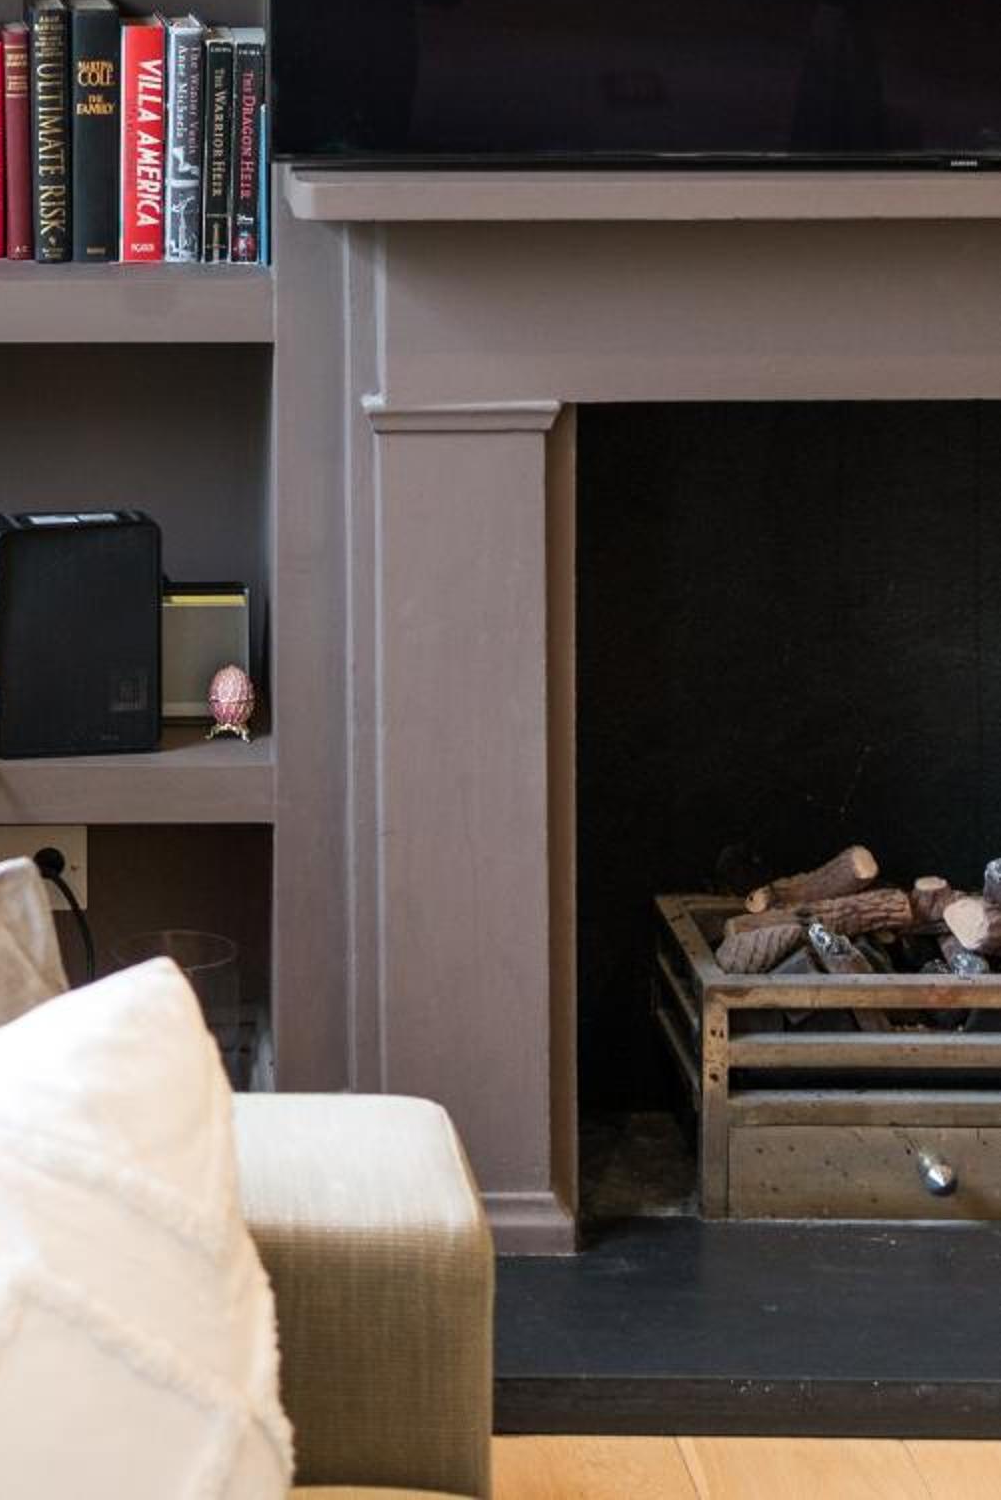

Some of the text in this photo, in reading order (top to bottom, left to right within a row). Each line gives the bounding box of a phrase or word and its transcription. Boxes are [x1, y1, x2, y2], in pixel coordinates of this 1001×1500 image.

[77, 69, 115, 87] COLE
[36, 62, 64, 177] ULTIMATE
[76, 103, 114, 115] FAMILY
[212, 91, 227, 158] WARRIOR
[240, 94, 257, 157] DRAGON
[136, 59, 162, 227] VILLA AMERICA
[212, 161, 226, 197] HEIR
[239, 161, 254, 200] HEIR
[39, 185, 66, 235] RISK
